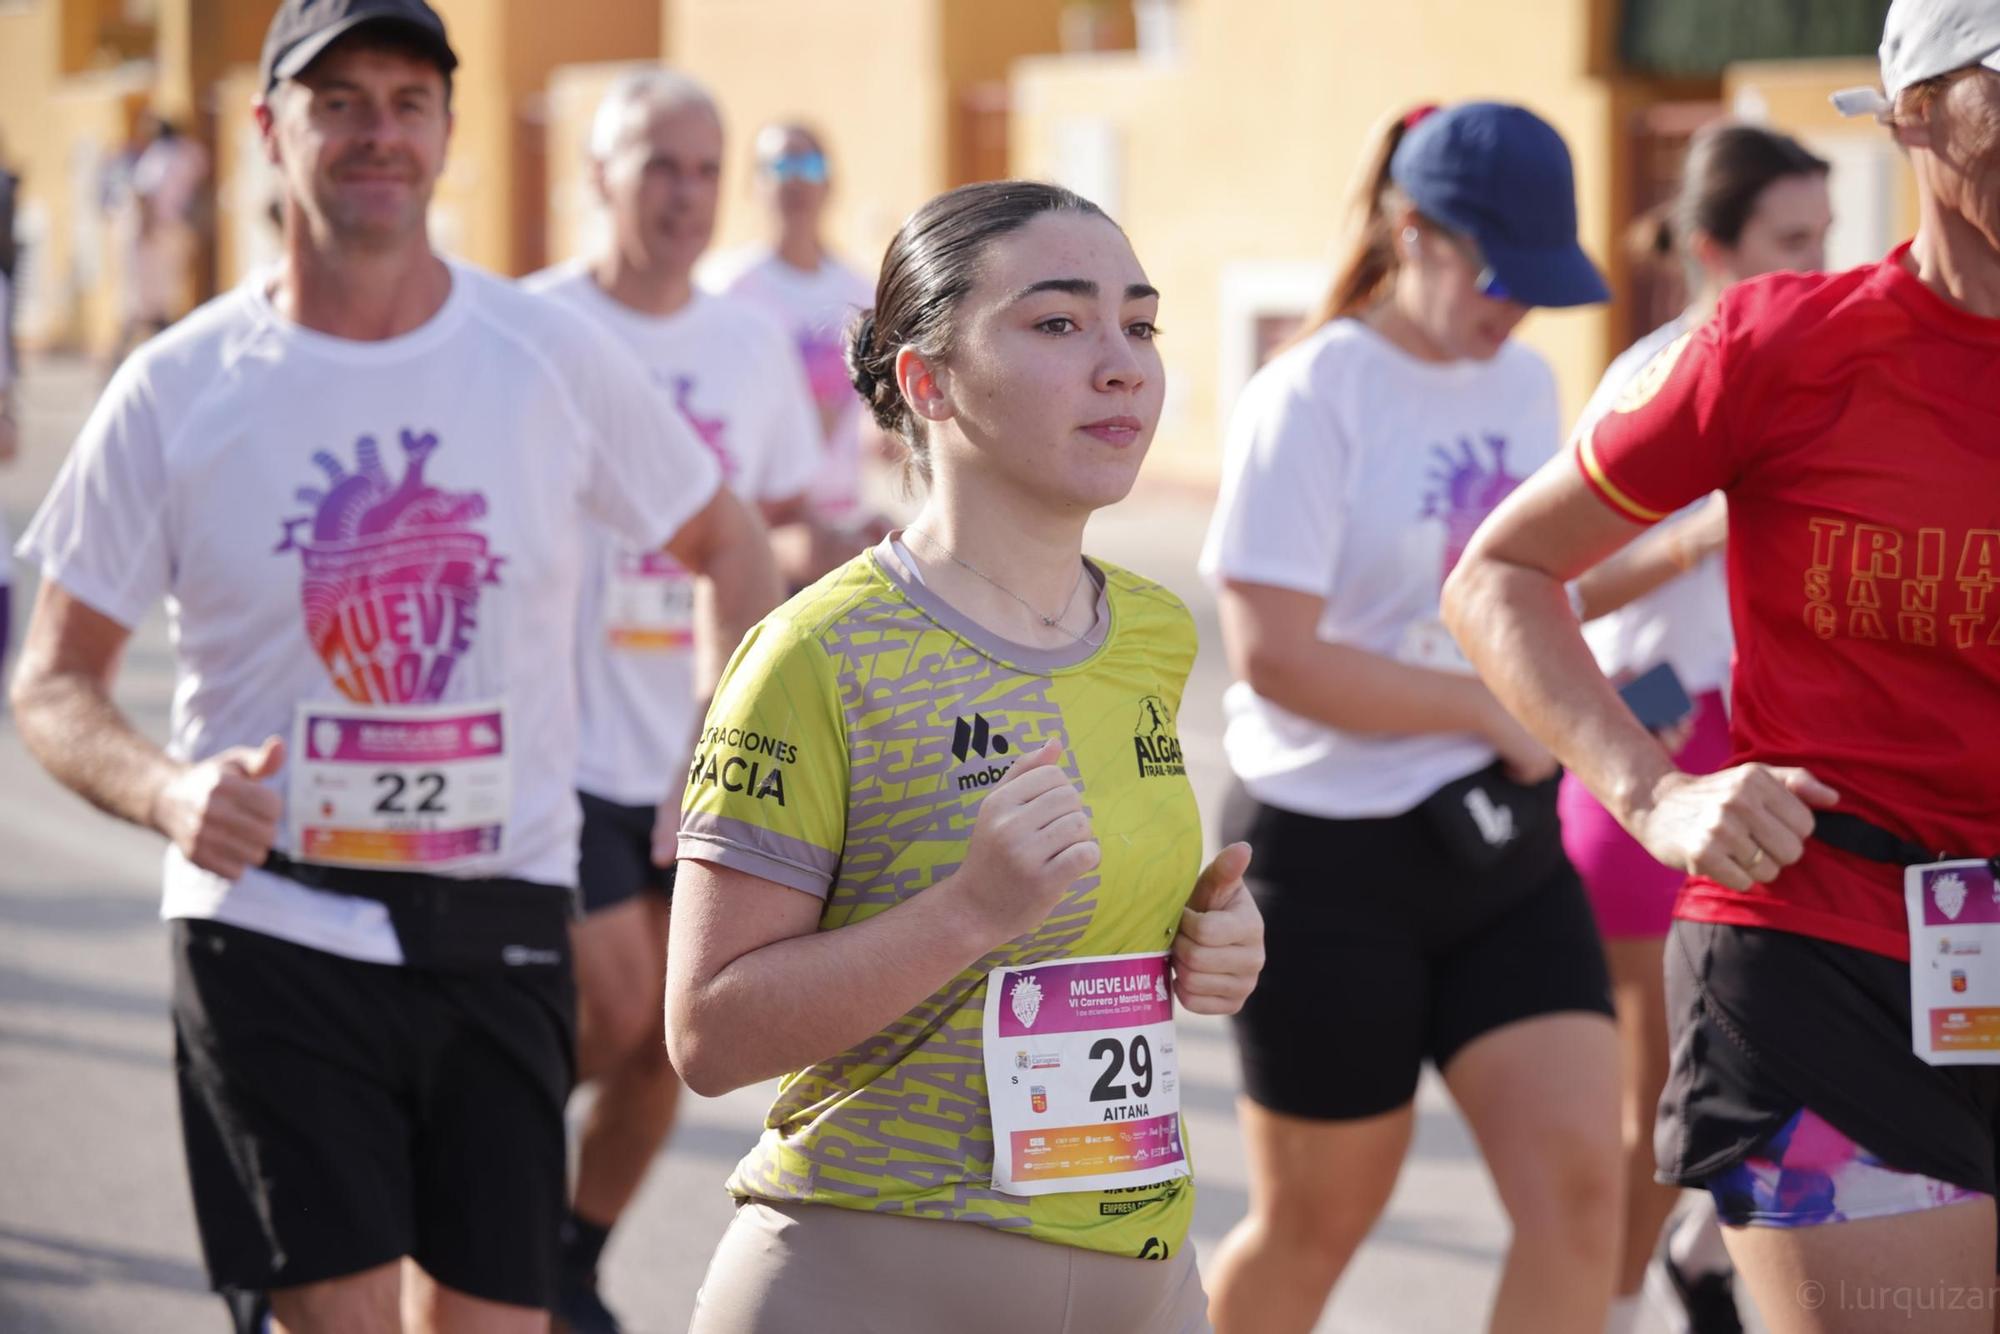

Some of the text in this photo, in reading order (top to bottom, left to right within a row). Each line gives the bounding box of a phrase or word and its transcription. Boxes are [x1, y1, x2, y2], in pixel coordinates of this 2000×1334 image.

[1809, 517, 2000, 581] TRIA
[1804, 568, 1993, 613] SANT
[700, 727, 798, 764] RACIONES
[373, 772, 446, 814] 22
[690, 753, 785, 807] RACIA
[957, 761, 1014, 791] mob
[1069, 998, 1078, 1008] VI
[1080, 996, 1113, 1007] Carrera
[1114, 997, 1118, 1006] y
[1070, 977, 1121, 996] MUEVE
[1123, 976, 1135, 992] LA
[1011, 1076, 1019, 1085] S
[1088, 1035, 1152, 1102] 29
[1104, 1103, 1149, 1121] AITANA
